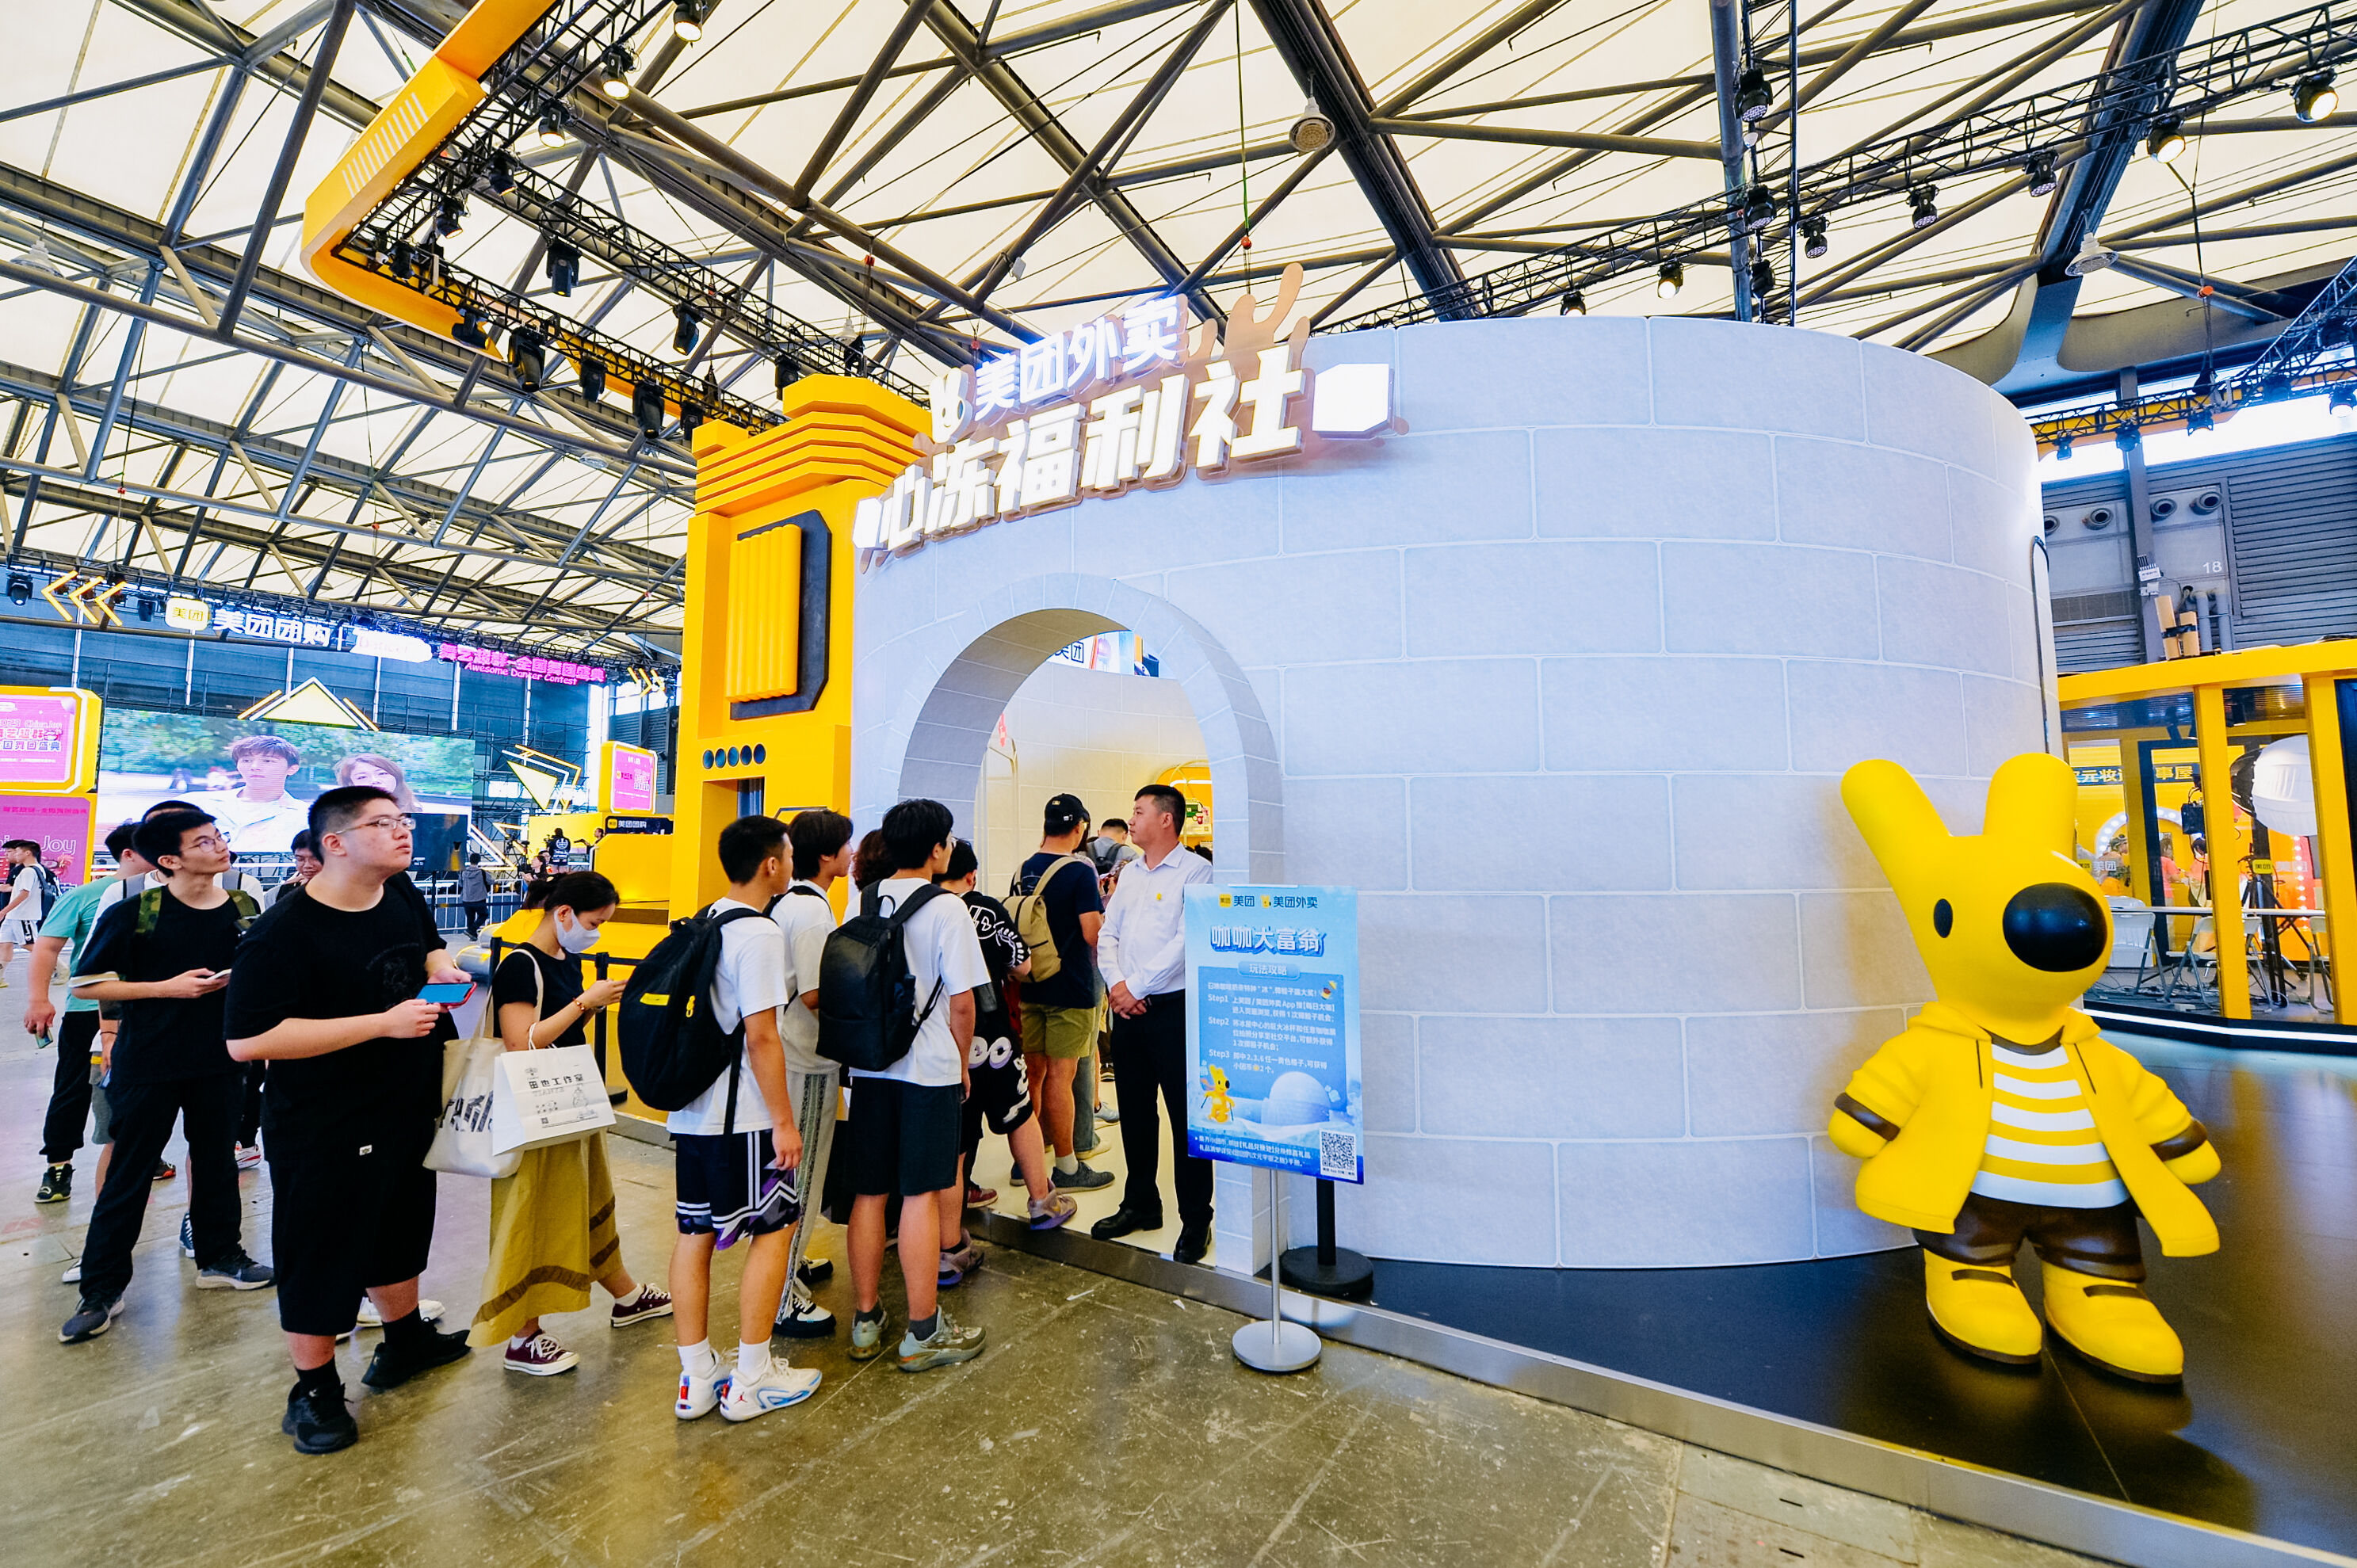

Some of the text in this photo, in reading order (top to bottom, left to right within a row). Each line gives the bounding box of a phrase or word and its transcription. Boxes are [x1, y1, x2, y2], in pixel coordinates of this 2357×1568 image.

[974, 292, 1182, 422] 美团外卖
[2202, 561, 2222, 574] 18
[172, 606, 331, 648] 美团 美团团购
[464, 662, 509, 676] Awesome
[544, 673, 578, 685] Contest
[0, 718, 21, 728] 023
[1233, 895, 1255, 907] 美团
[1273, 896, 1318, 909] 美团外卖
[1211, 925, 1323, 954] 咖咖大富翁
[1249, 963, 1287, 976] 玩法攻略
[1208, 994, 1228, 1004] Step1
[1208, 1016, 1229, 1027] Step2
[1209, 1048, 1230, 1059] Step3
